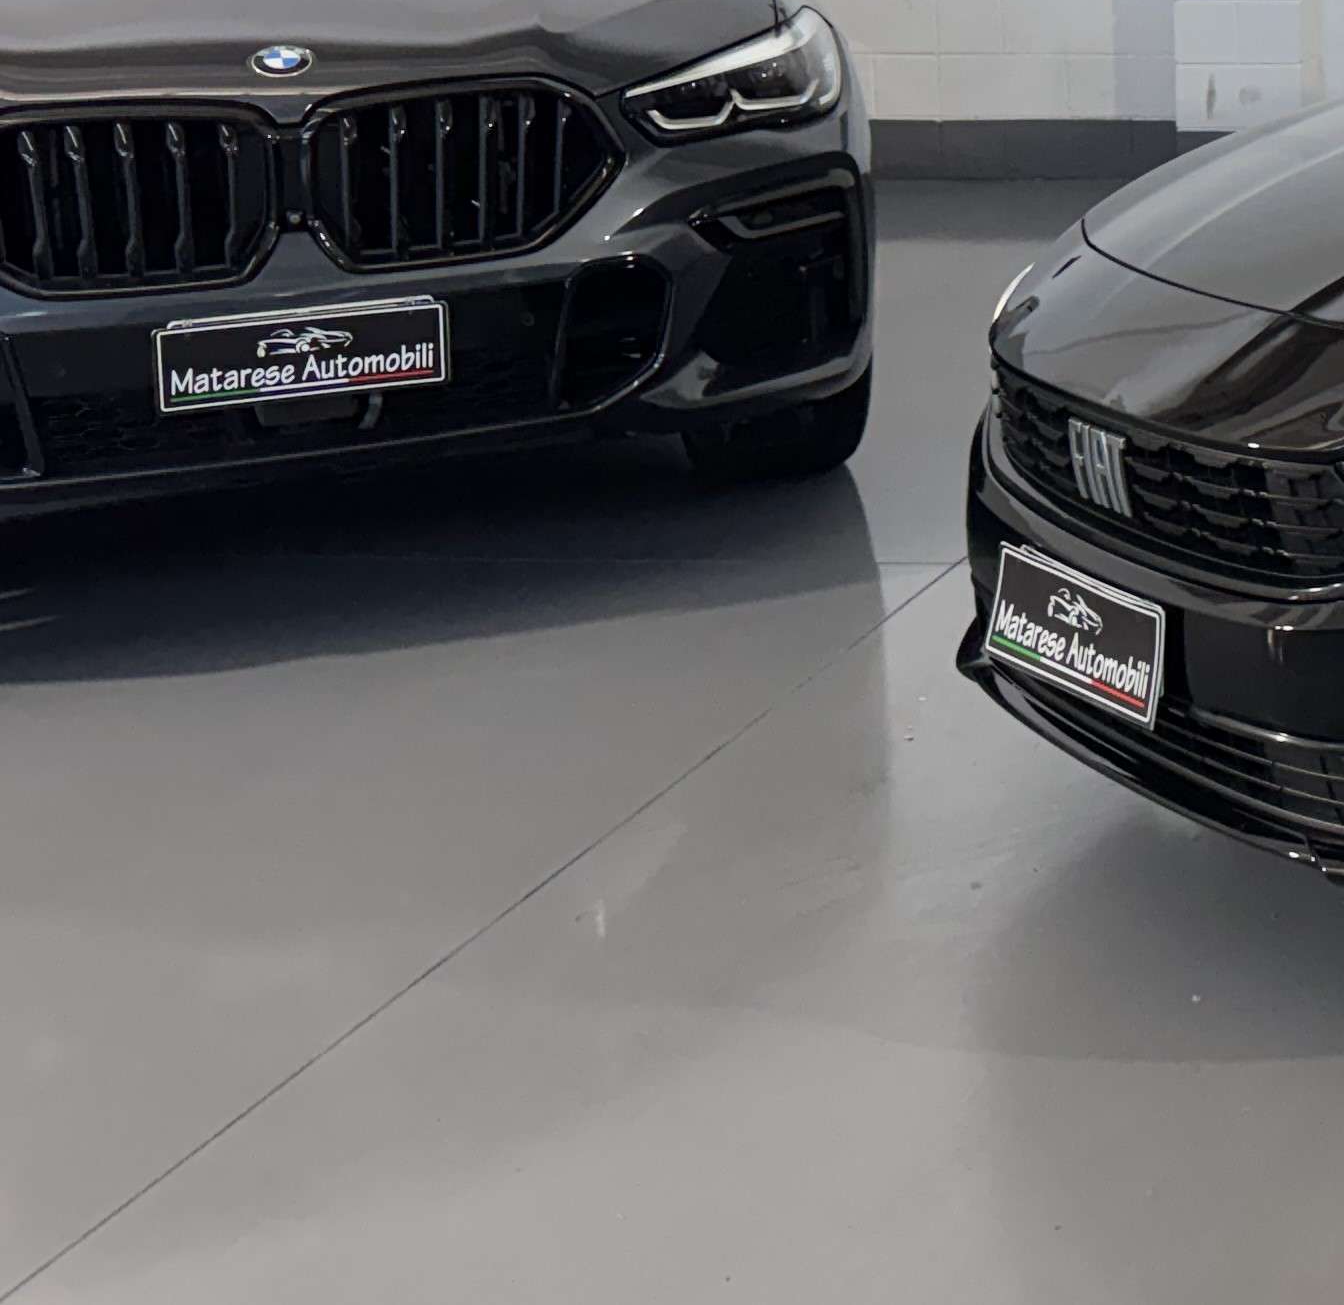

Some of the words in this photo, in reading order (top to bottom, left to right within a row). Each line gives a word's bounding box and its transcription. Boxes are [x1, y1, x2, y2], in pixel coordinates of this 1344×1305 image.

[170, 364, 296, 396] Matarese
[301, 342, 434, 381] Automobili
[1068, 417, 1133, 518] FIAT
[994, 599, 1066, 661] Matarese
[1066, 632, 1151, 700] Automobili
